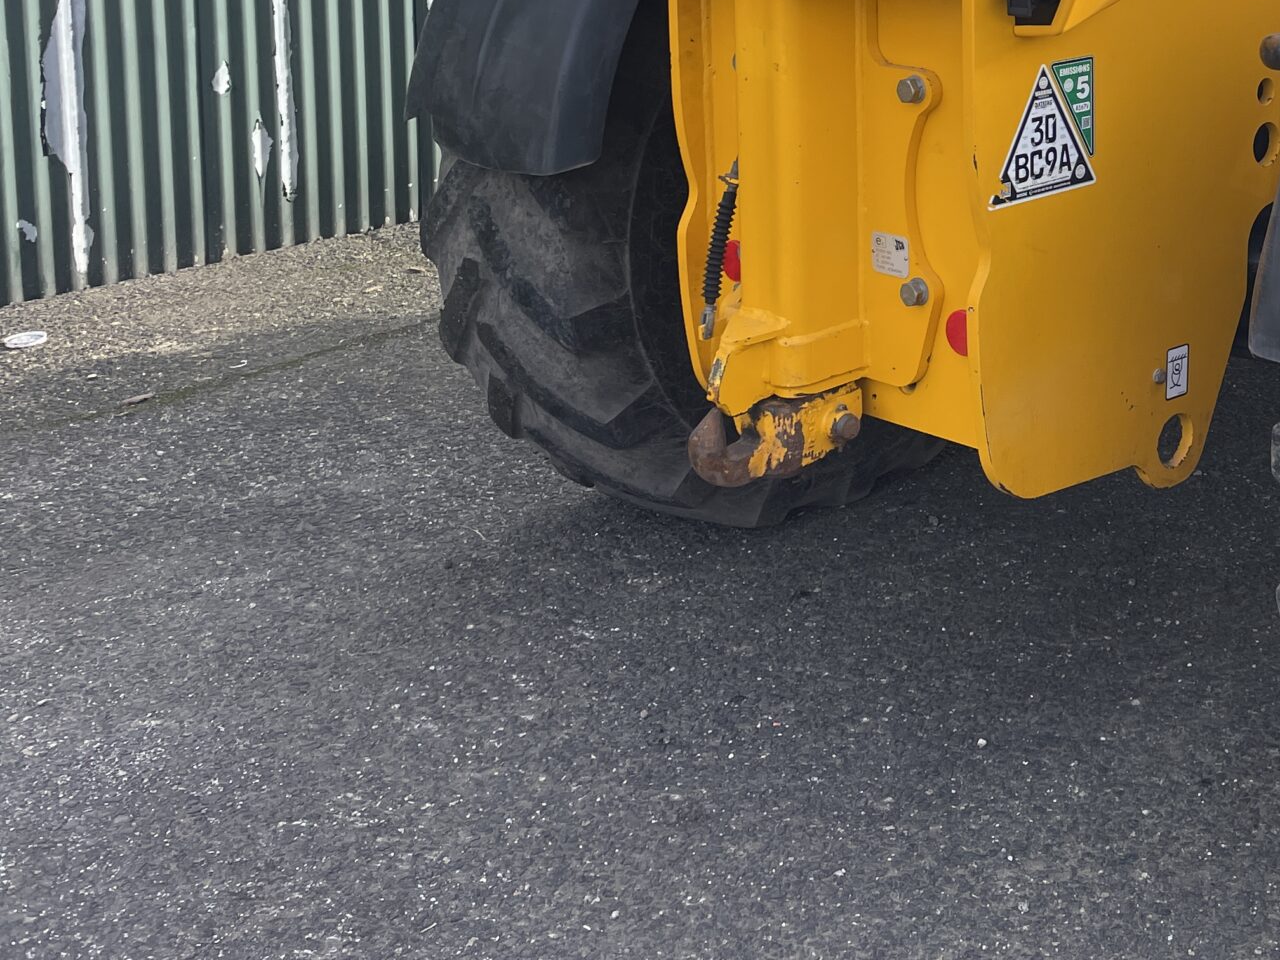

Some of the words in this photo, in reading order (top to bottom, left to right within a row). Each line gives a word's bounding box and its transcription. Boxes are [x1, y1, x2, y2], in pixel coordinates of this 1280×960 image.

[1059, 63, 1091, 76] EMISSIONS
[1076, 75, 1090, 99] 5
[1015, 143, 1072, 185] BC9A
